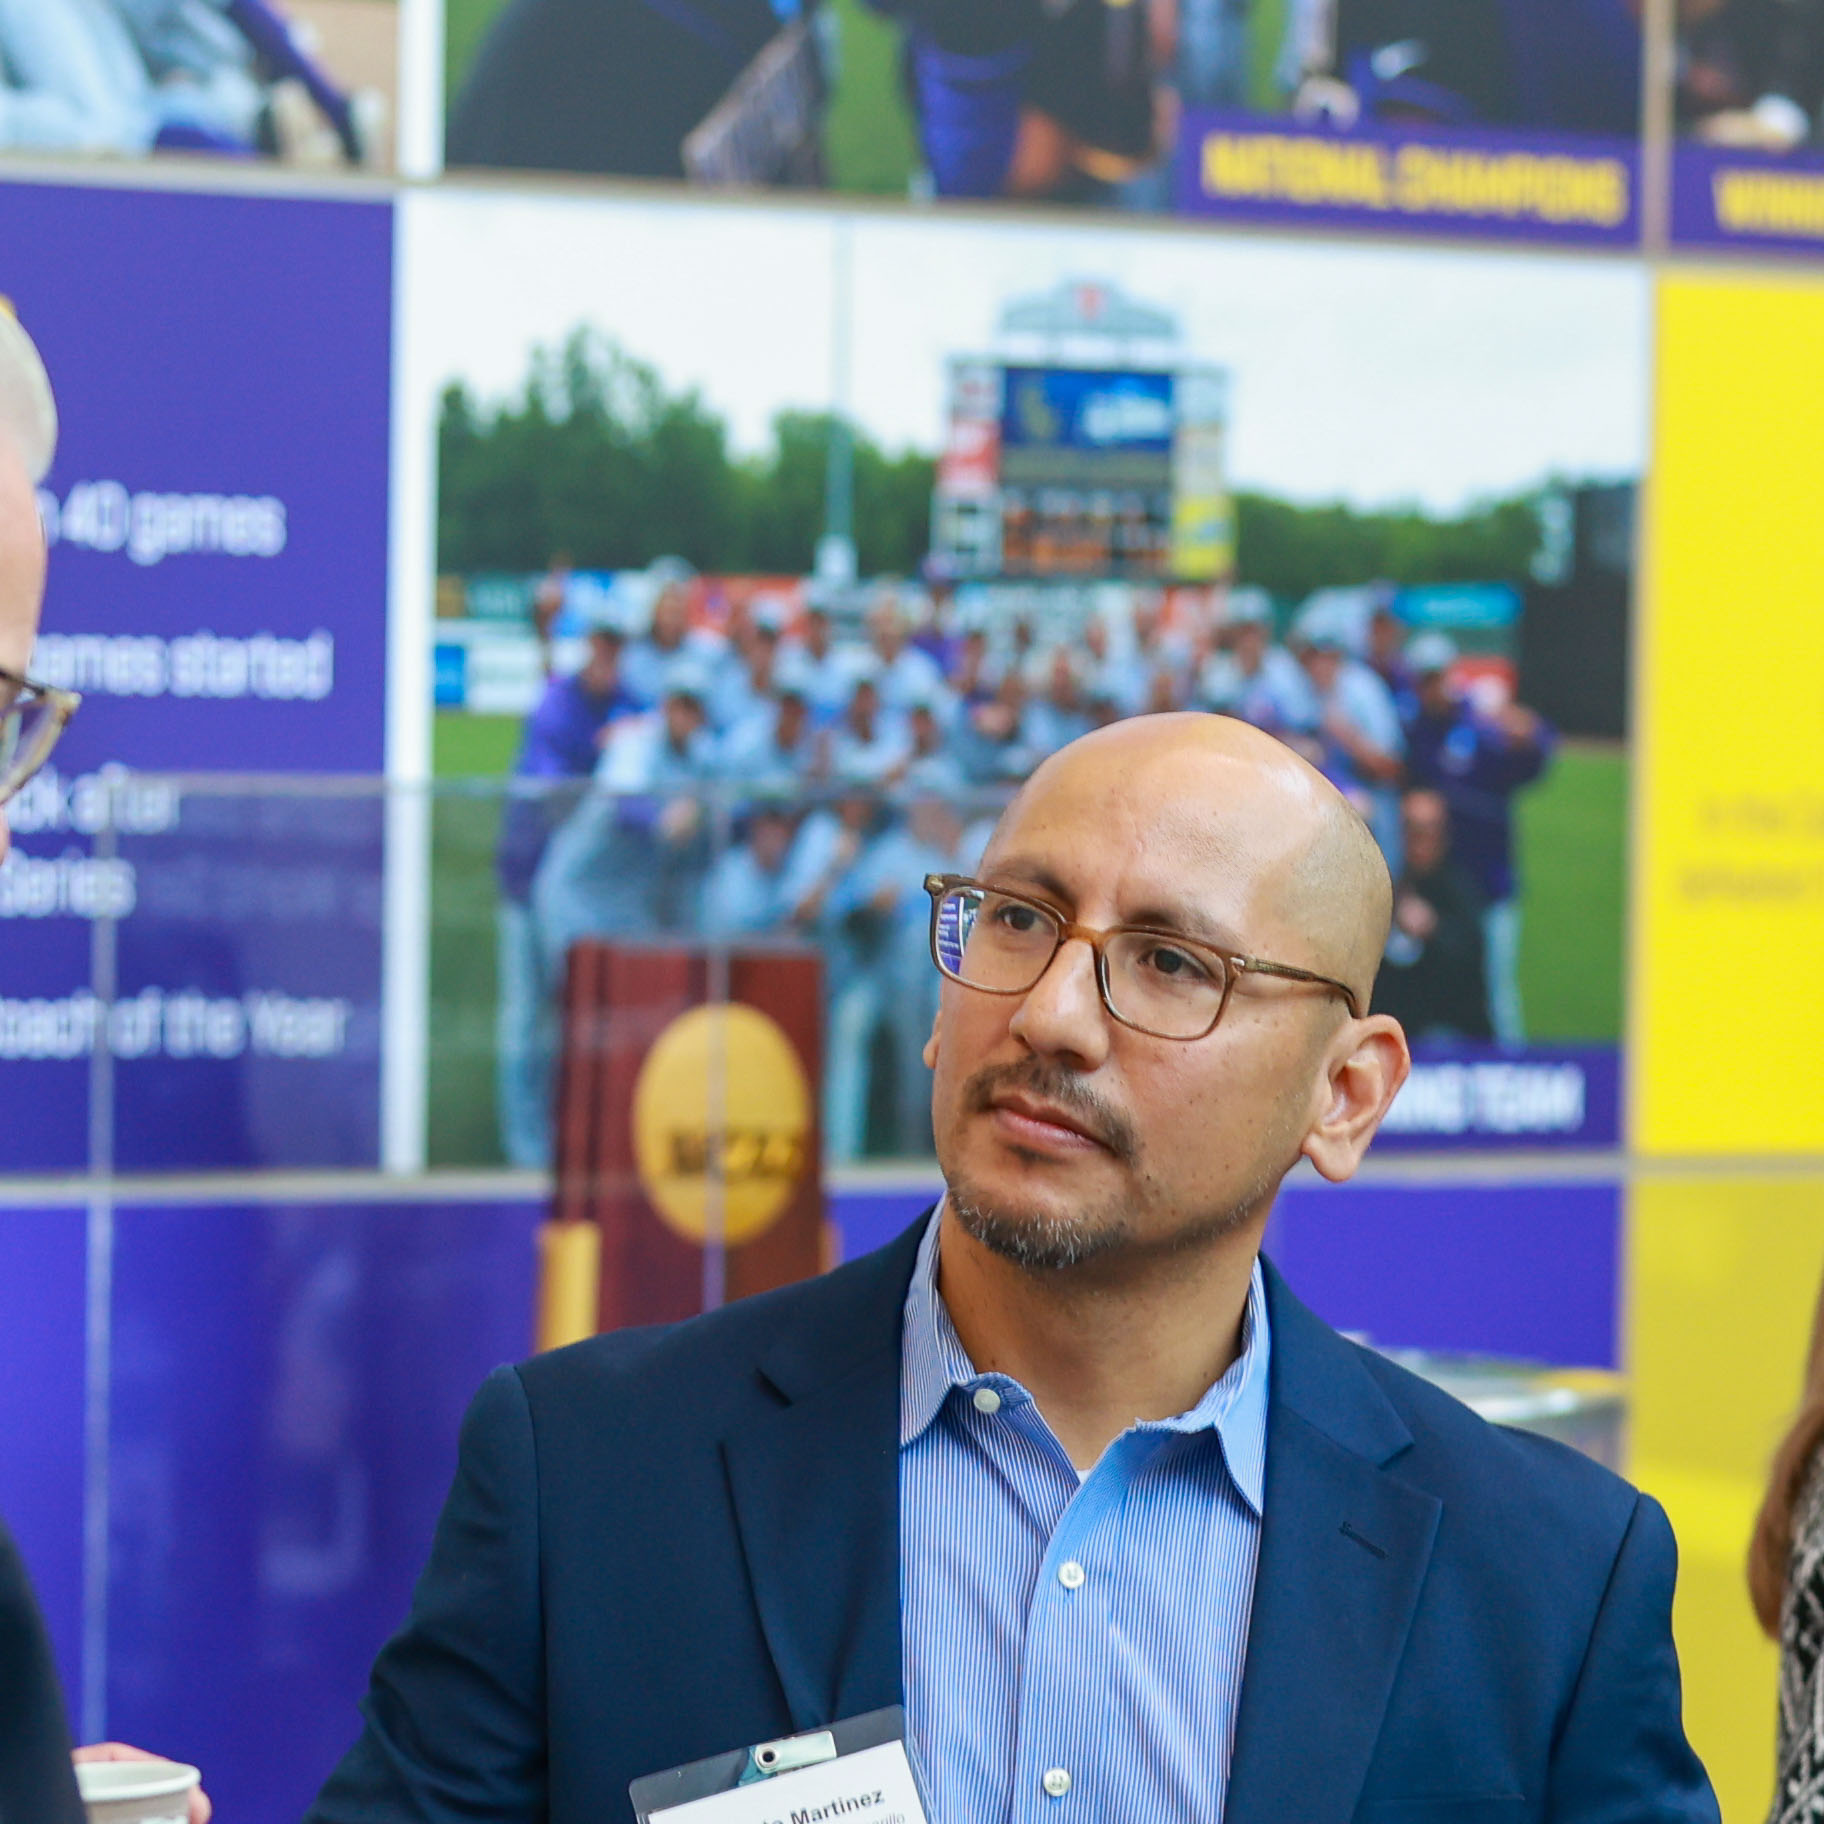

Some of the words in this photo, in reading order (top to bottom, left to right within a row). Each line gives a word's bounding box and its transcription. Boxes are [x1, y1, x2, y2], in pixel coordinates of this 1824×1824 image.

[127, 491, 286, 566] games
[32, 632, 167, 697] ames
[170, 628, 334, 701] started
[106, 984, 164, 1059] of
[165, 985, 246, 1059] the
[244, 987, 355, 1058] Year
